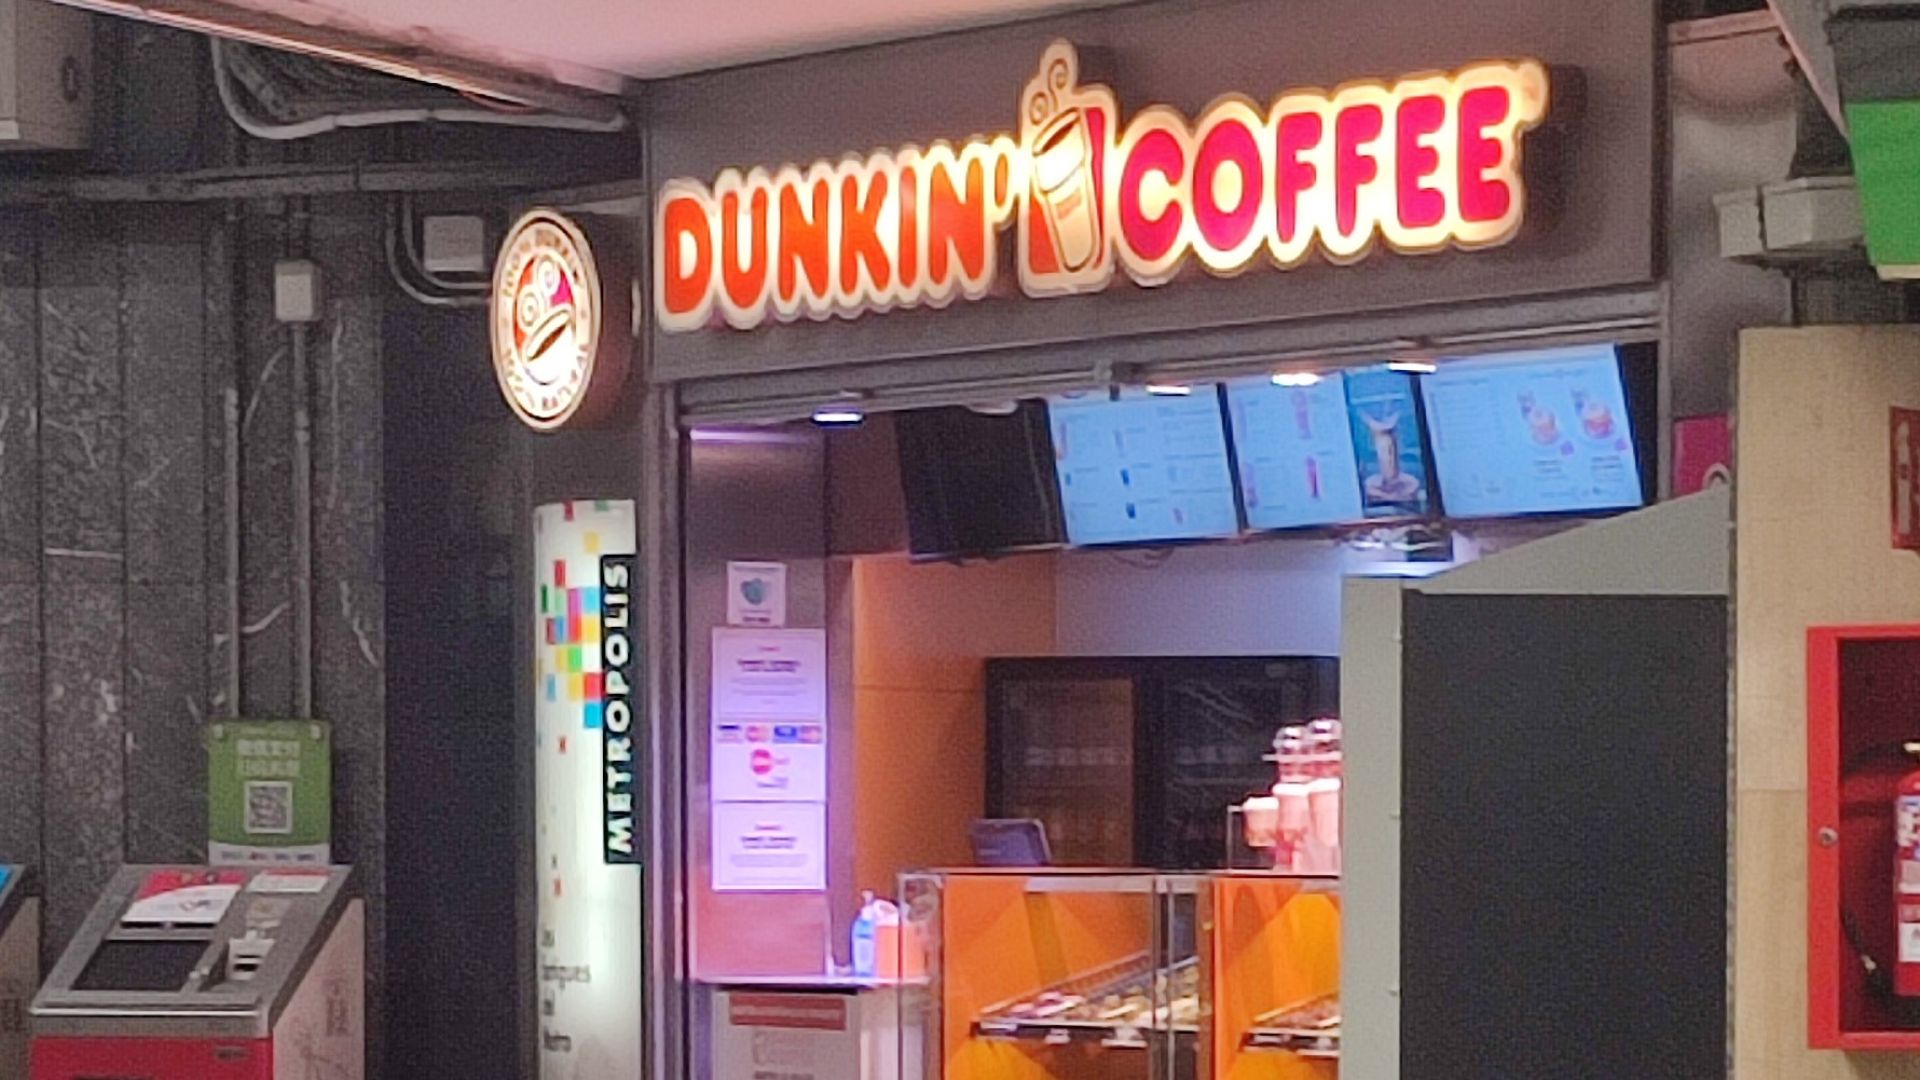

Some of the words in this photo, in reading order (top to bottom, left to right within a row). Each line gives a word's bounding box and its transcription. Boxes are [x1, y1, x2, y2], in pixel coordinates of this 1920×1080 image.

[662, 152, 1010, 316] DUNKIN'
[1117, 83, 1512, 263] COFFEE
[603, 562, 634, 856] METROPOLIS
